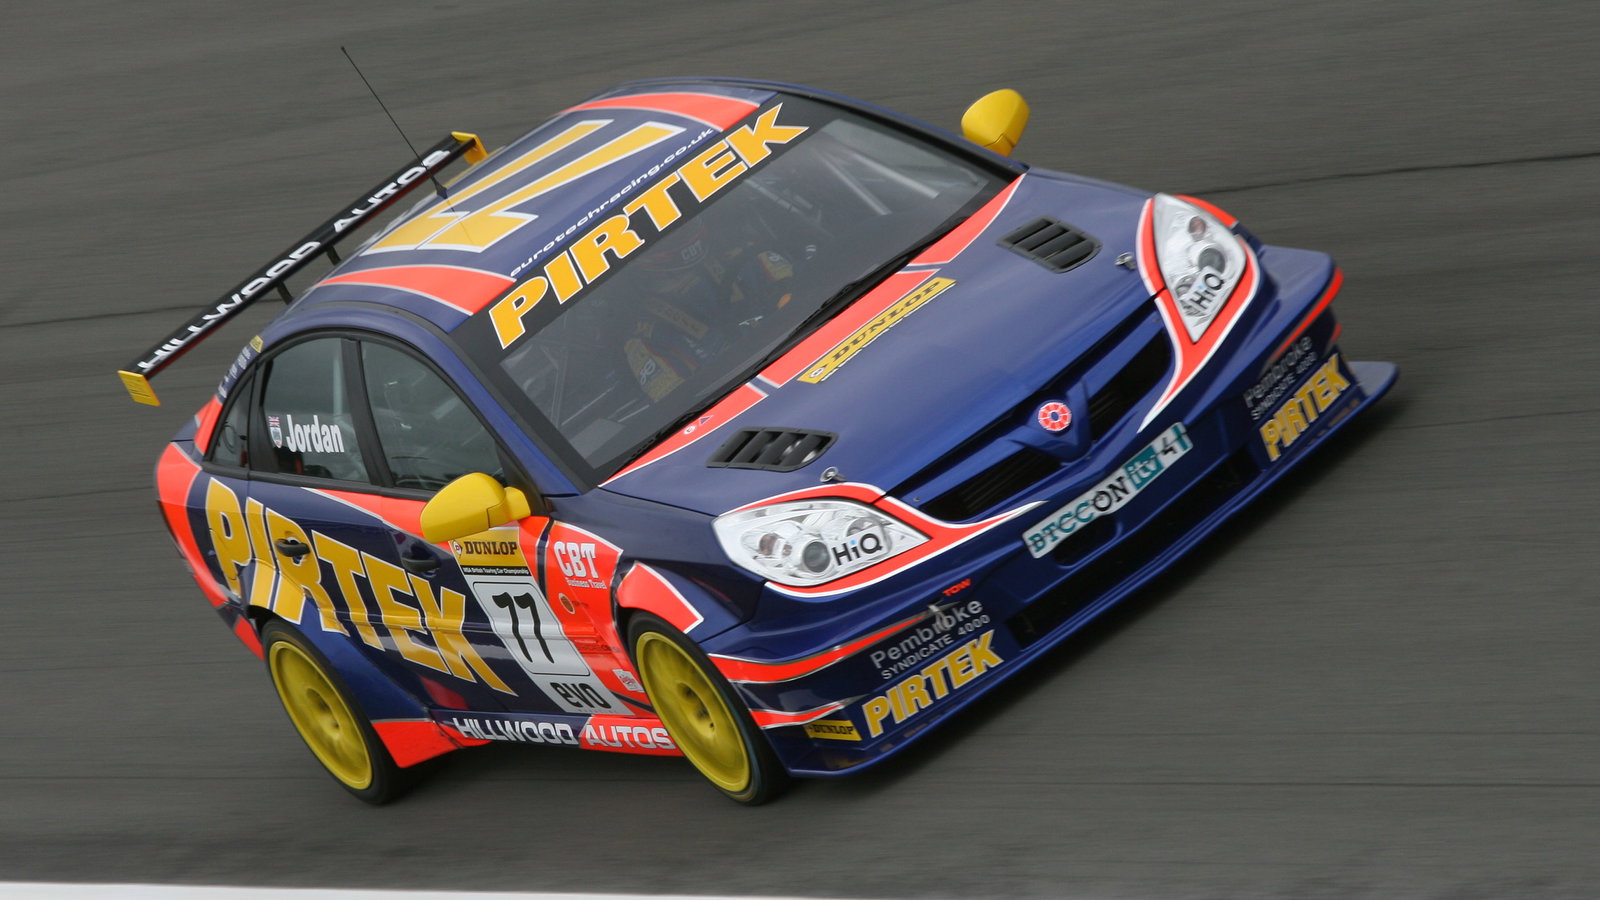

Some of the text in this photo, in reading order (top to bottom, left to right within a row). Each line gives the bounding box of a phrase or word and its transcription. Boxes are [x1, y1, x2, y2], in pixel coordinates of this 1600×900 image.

[488, 102, 809, 350] PIRTEK
[510, 127, 713, 277] eurotechracing.co.uk
[138, 150, 450, 370] HILLWOOD AUTOS
[1189, 273, 1224, 310] HiQ
[832, 281, 940, 362] DUNLOP
[286, 414, 345, 453] Jordan
[1259, 353, 1349, 461] PIRTEK
[464, 541, 518, 555] DUNLOP
[554, 541, 599, 579] CBT
[832, 533, 882, 566] HiQ
[205, 477, 519, 697] PIRTEK
[942, 578, 972, 597] TOW
[492, 592, 554, 664] 77
[870, 600, 983, 669] Pembroke
[881, 614, 991, 680] SYNDICATE 4000
[550, 682, 612, 709] evo
[863, 629, 1004, 738] PIRTEK
[453, 717, 677, 750] HILLWOOD AUTOS
[813, 723, 854, 735] DUNLOP
